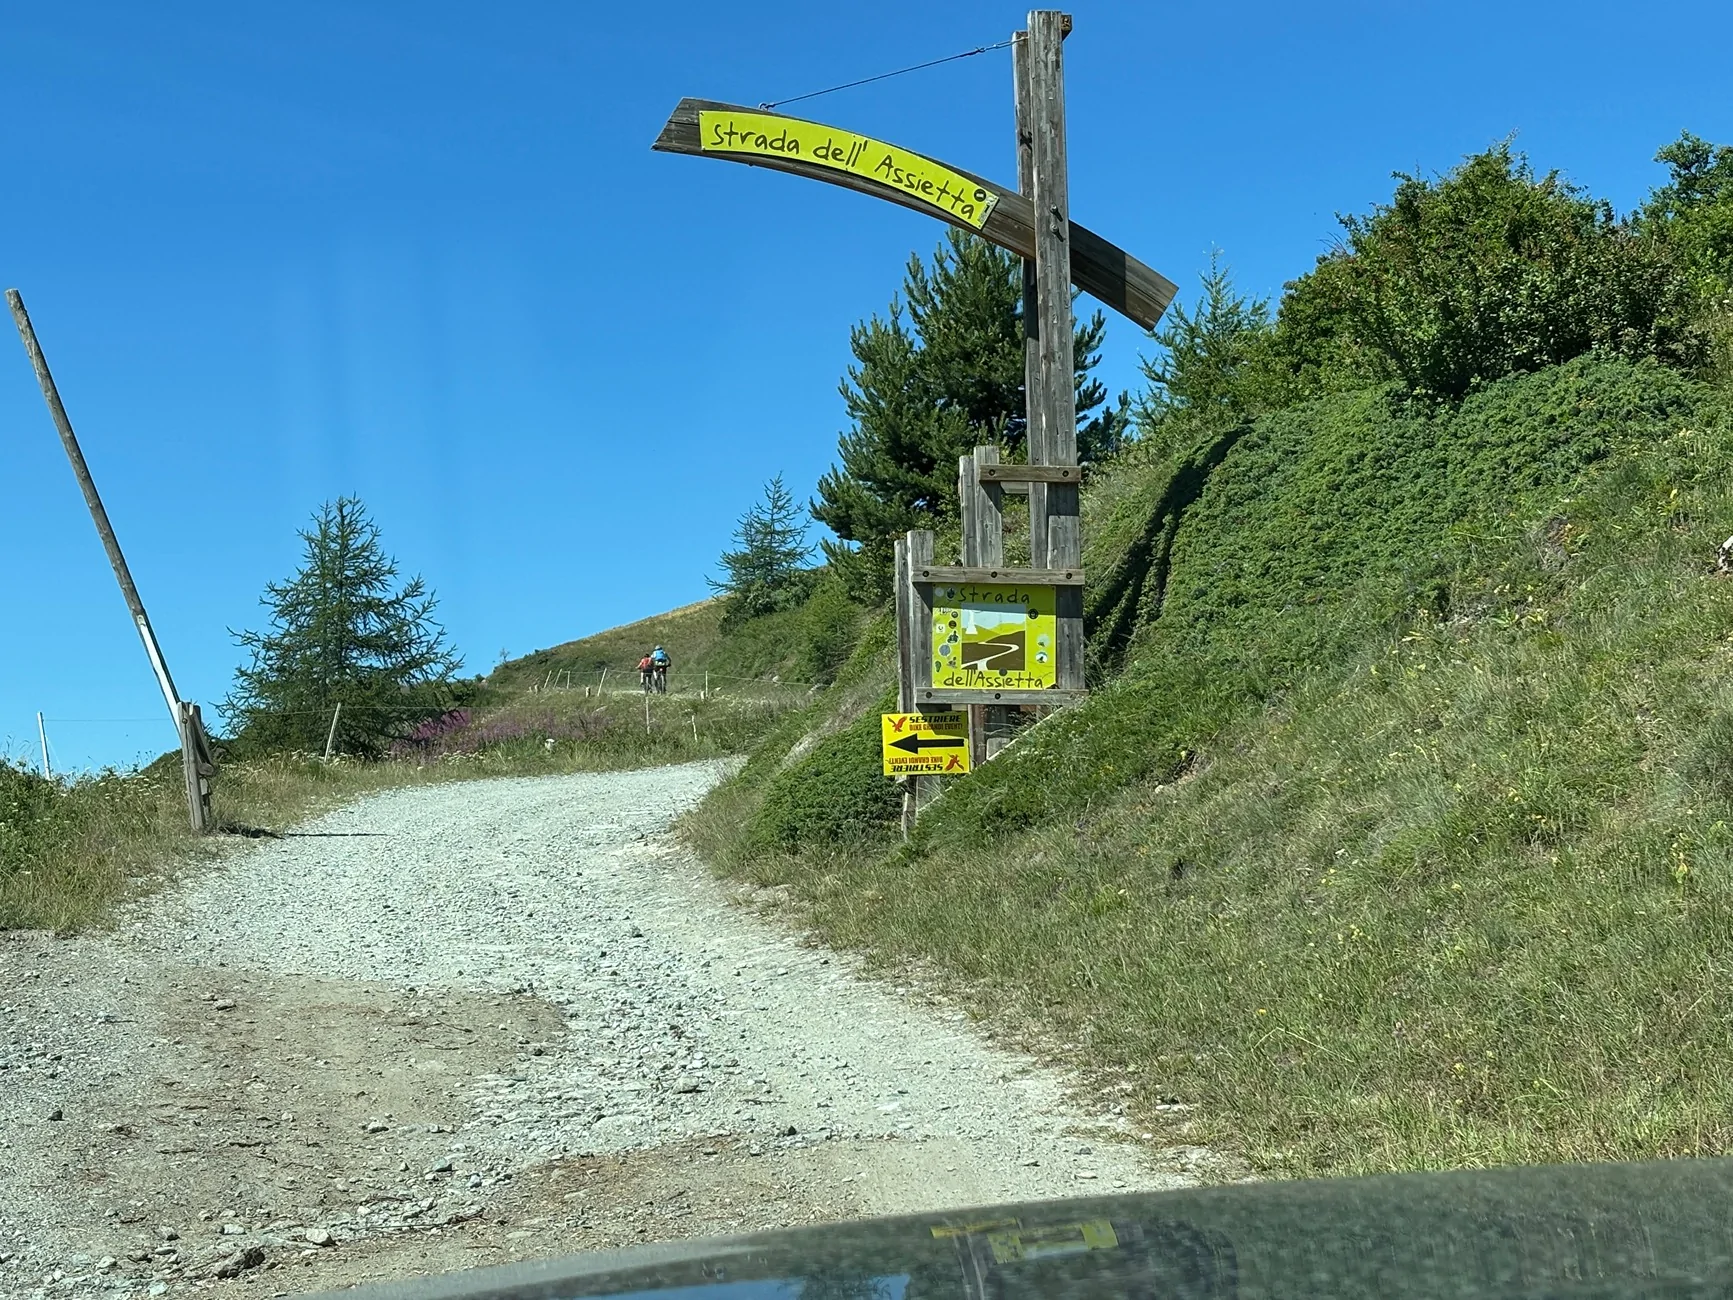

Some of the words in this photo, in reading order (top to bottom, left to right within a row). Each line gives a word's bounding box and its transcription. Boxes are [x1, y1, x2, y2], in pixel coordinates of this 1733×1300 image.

[813, 138, 868, 168] dell'
[874, 154, 975, 220] Assietta
[943, 668, 1044, 688] dell'Assietta
[909, 715, 961, 723] SESTRIERE
[891, 764, 943, 772] SESTRIERE
